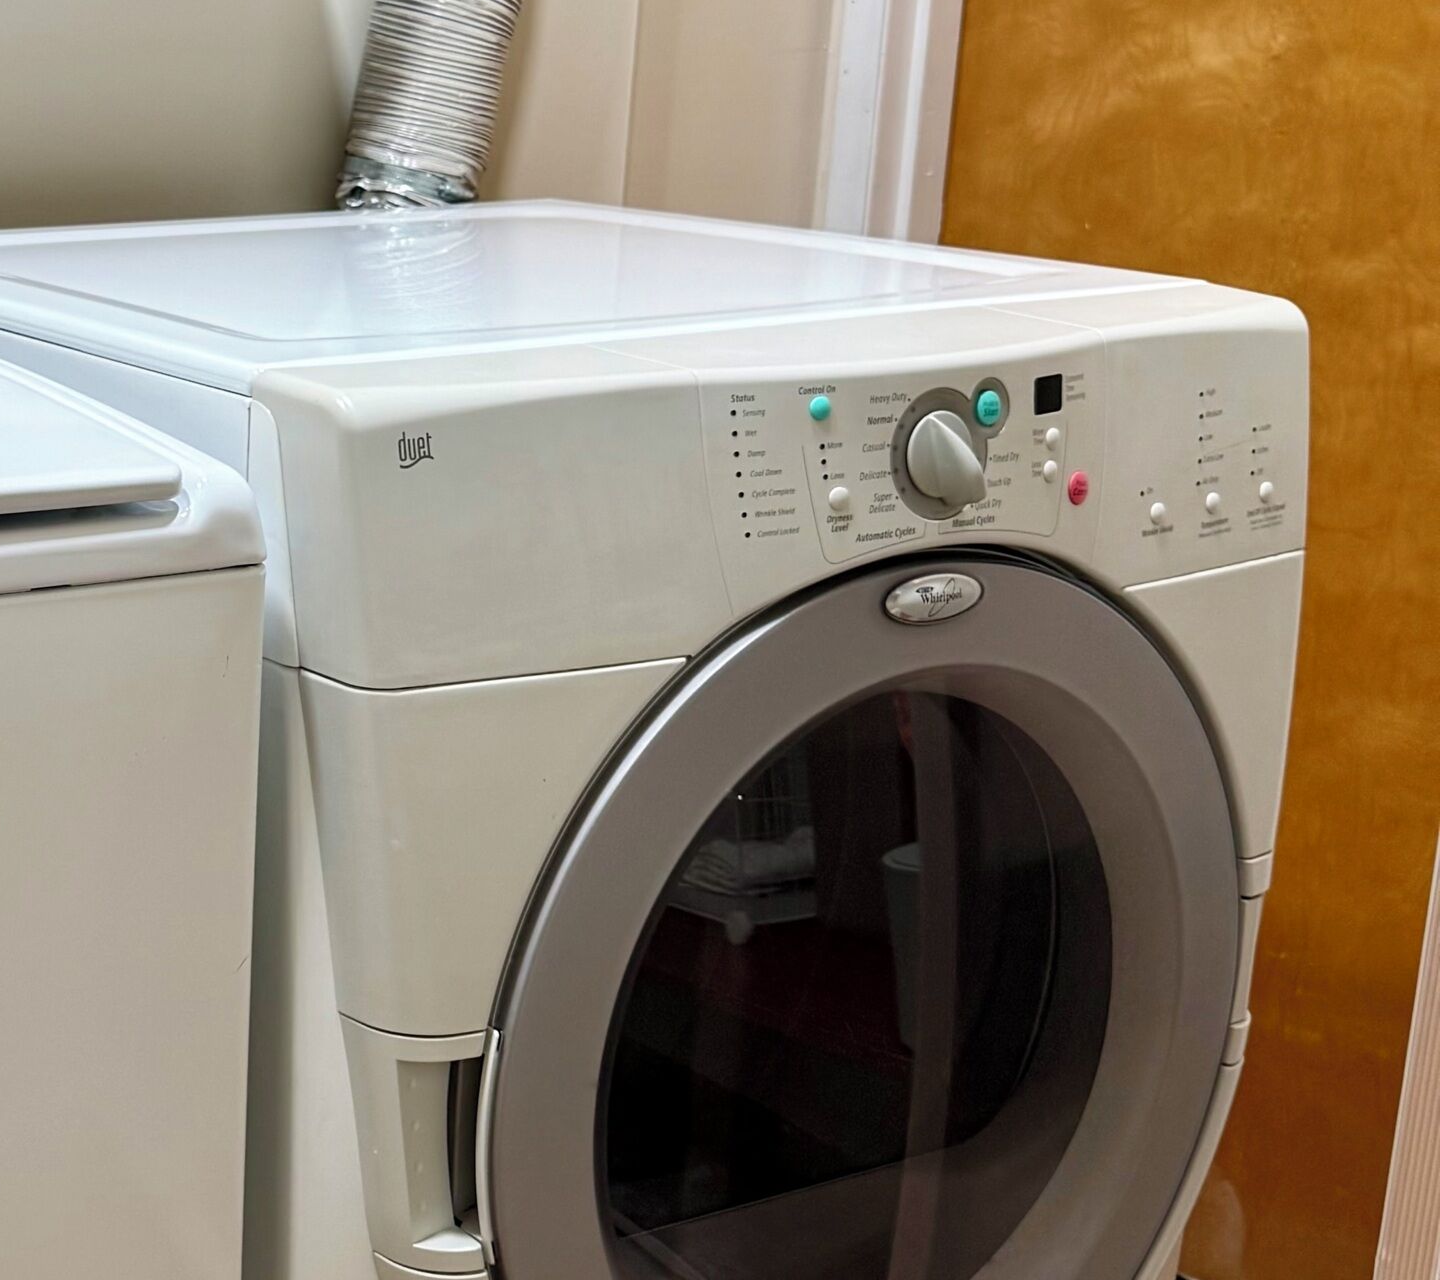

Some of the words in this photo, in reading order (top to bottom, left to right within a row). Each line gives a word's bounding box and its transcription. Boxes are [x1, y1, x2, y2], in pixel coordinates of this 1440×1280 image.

[798, 386, 825, 395] Control
[825, 385, 836, 394] On
[731, 394, 755, 403] Status
[870, 393, 891, 405] Heavy
[891, 392, 907, 403] Duty
[867, 414, 893, 426] Normal
[397, 431, 434, 466] duet
[862, 441, 886, 452] Casual
[992, 453, 1009, 463] Timed
[1009, 452, 1019, 463] Dry
[860, 470, 888, 481] Delicate
[752, 490, 768, 499] Cycle
[768, 488, 796, 497] Complete
[873, 492, 893, 503] Super
[869, 503, 896, 514] Delicate
[991, 498, 1002, 508] Dry
[952, 517, 976, 528] Manual
[976, 514, 995, 526] Cycles
[831, 523, 850, 533] Level
[856, 529, 894, 543] Automatic
[895, 526, 916, 540] Cycles
[920, 586, 962, 605] Whirlpool
